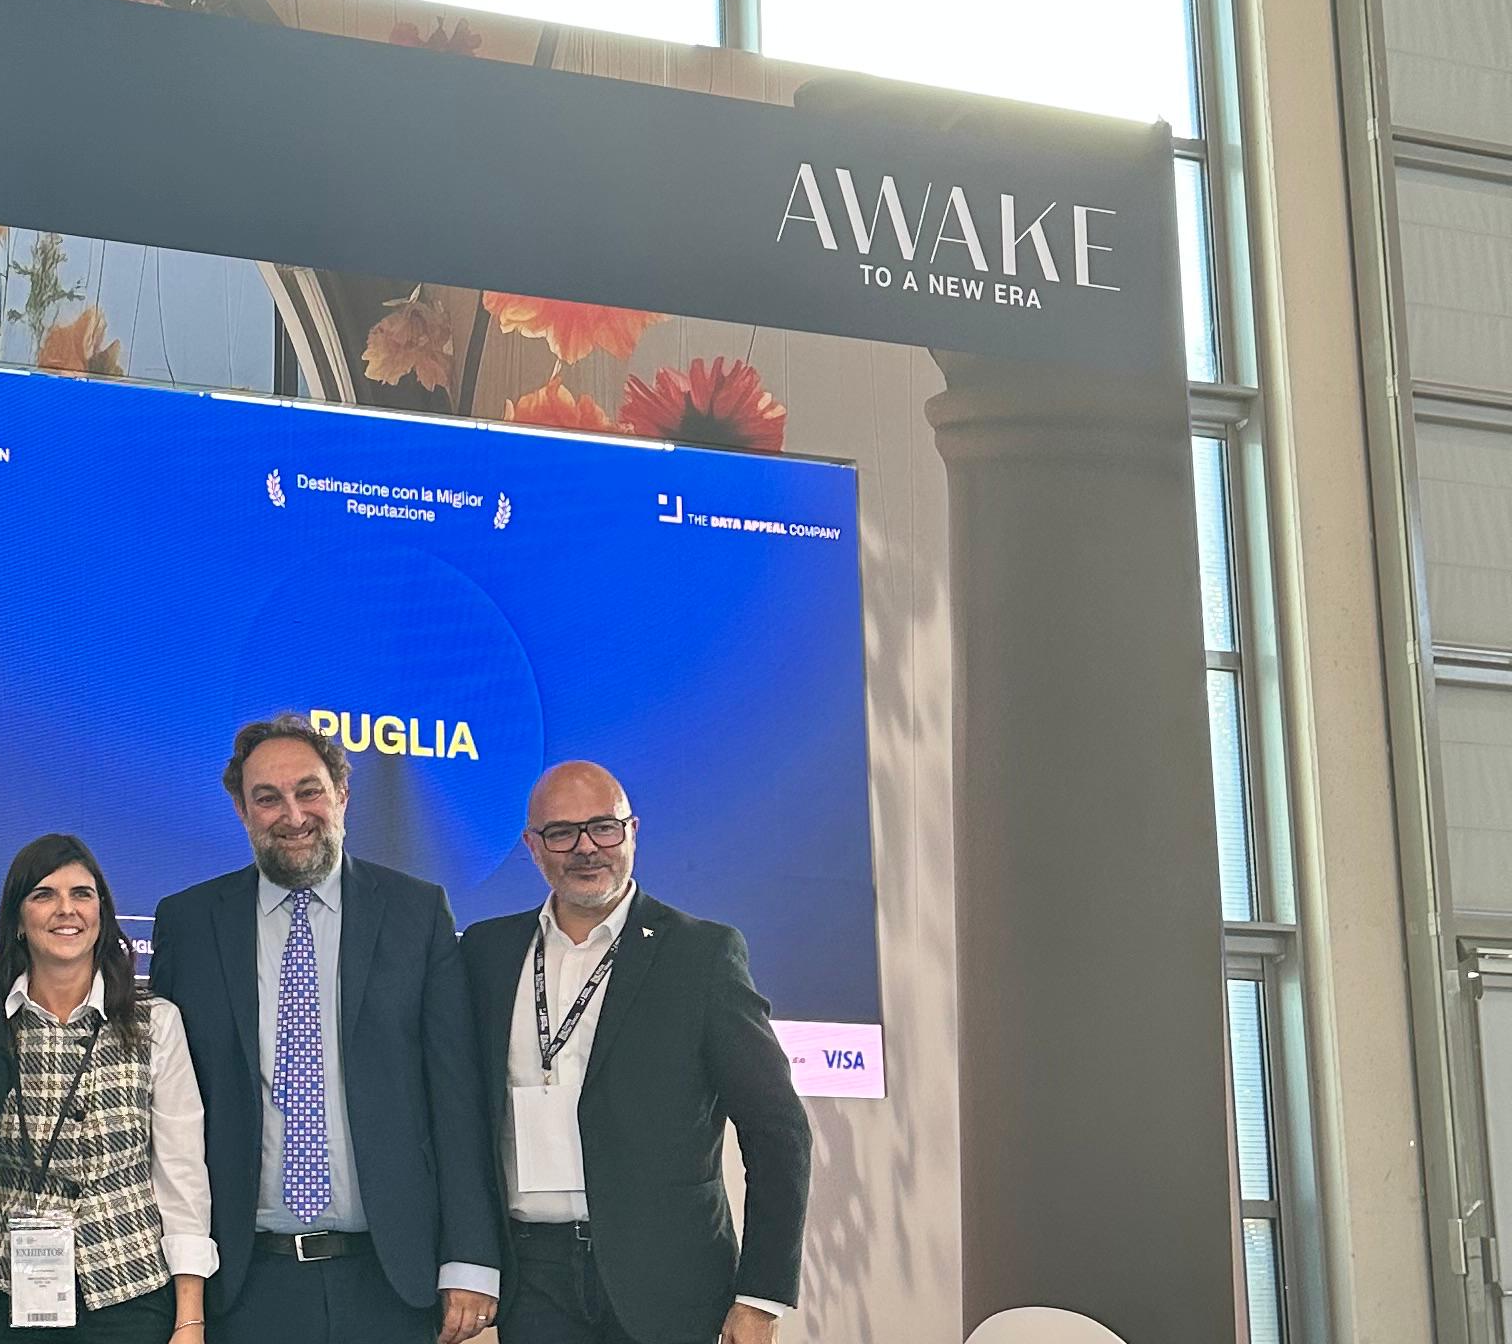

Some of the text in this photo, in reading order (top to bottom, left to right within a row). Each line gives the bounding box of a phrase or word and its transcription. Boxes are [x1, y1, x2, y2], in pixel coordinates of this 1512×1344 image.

[777, 163, 1121, 292] AWAKE
[859, 264, 1042, 309] TO A NEW ERA
[297, 474, 483, 508] Destinazione con la Miglior
[347, 500, 435, 522] Reputazione
[688, 513, 840, 540] THE DATA APPEAL COMPANY
[310, 709, 480, 761] PUGLIA
[822, 1049, 865, 1070] VISA
